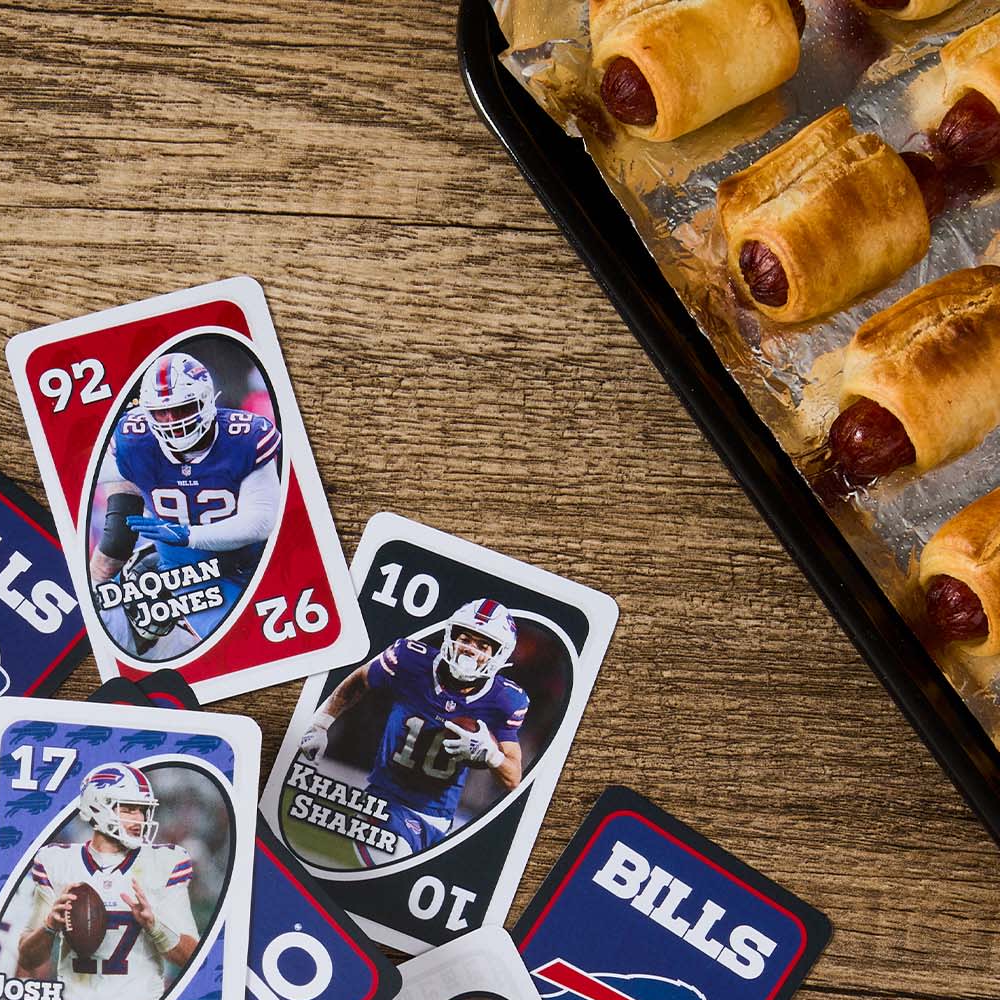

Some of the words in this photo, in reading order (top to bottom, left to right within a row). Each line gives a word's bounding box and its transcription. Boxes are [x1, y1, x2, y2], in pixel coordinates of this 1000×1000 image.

[38, 358, 113, 413] 92
[228, 413, 253, 435] 92
[151, 488, 237, 527] 92
[97, 557, 221, 611] DAQUAN
[136, 586, 224, 628] JONES
[371, 562, 440, 617] 10
[255, 588, 329, 643] 92
[10, 745, 78, 794] 17
[286, 762, 391, 823] KHALIL
[289, 792, 401, 855] SHAKIR
[407, 874, 477, 932] 10
[592, 840, 779, 981] BILLS
